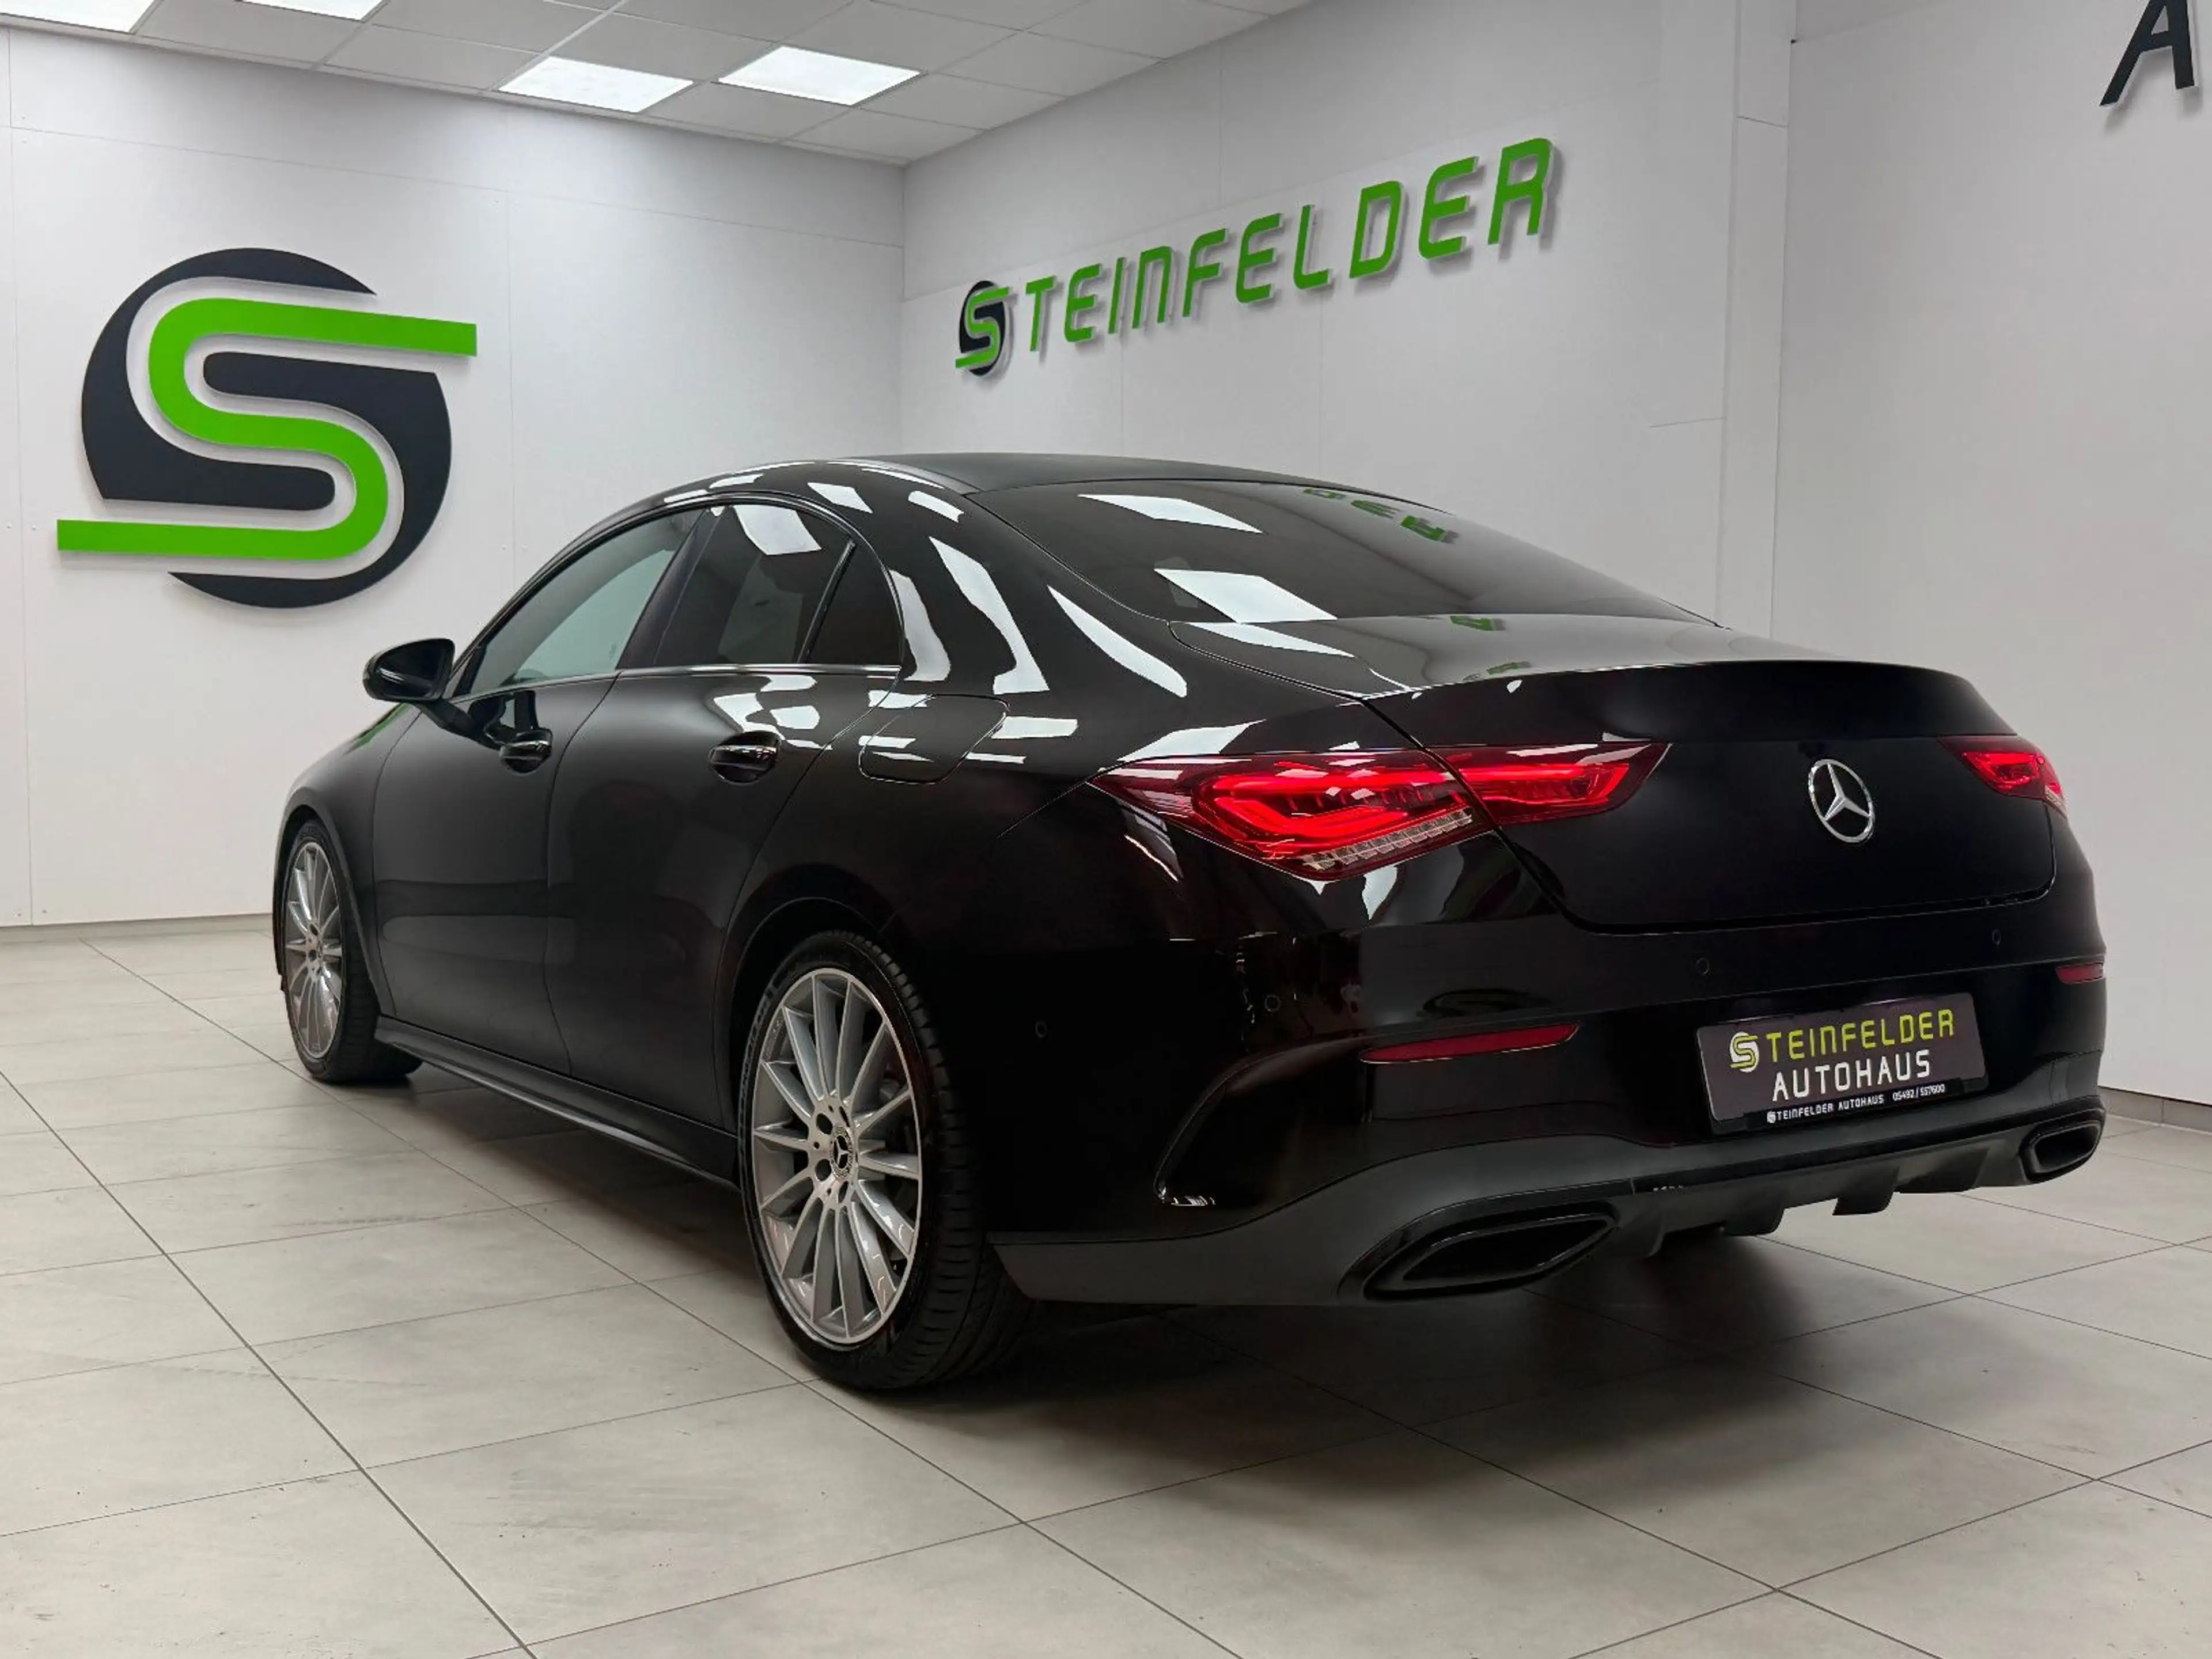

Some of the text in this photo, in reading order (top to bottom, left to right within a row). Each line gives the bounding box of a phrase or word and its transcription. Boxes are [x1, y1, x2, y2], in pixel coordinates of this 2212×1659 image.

[2100, 0, 2195, 106] A
[1730, 1009, 1953, 1073] STEINFELDER
[1772, 1050, 1930, 1101] AUTOHAUS
[1838, 1095, 1884, 1111] AUTOHAUS
